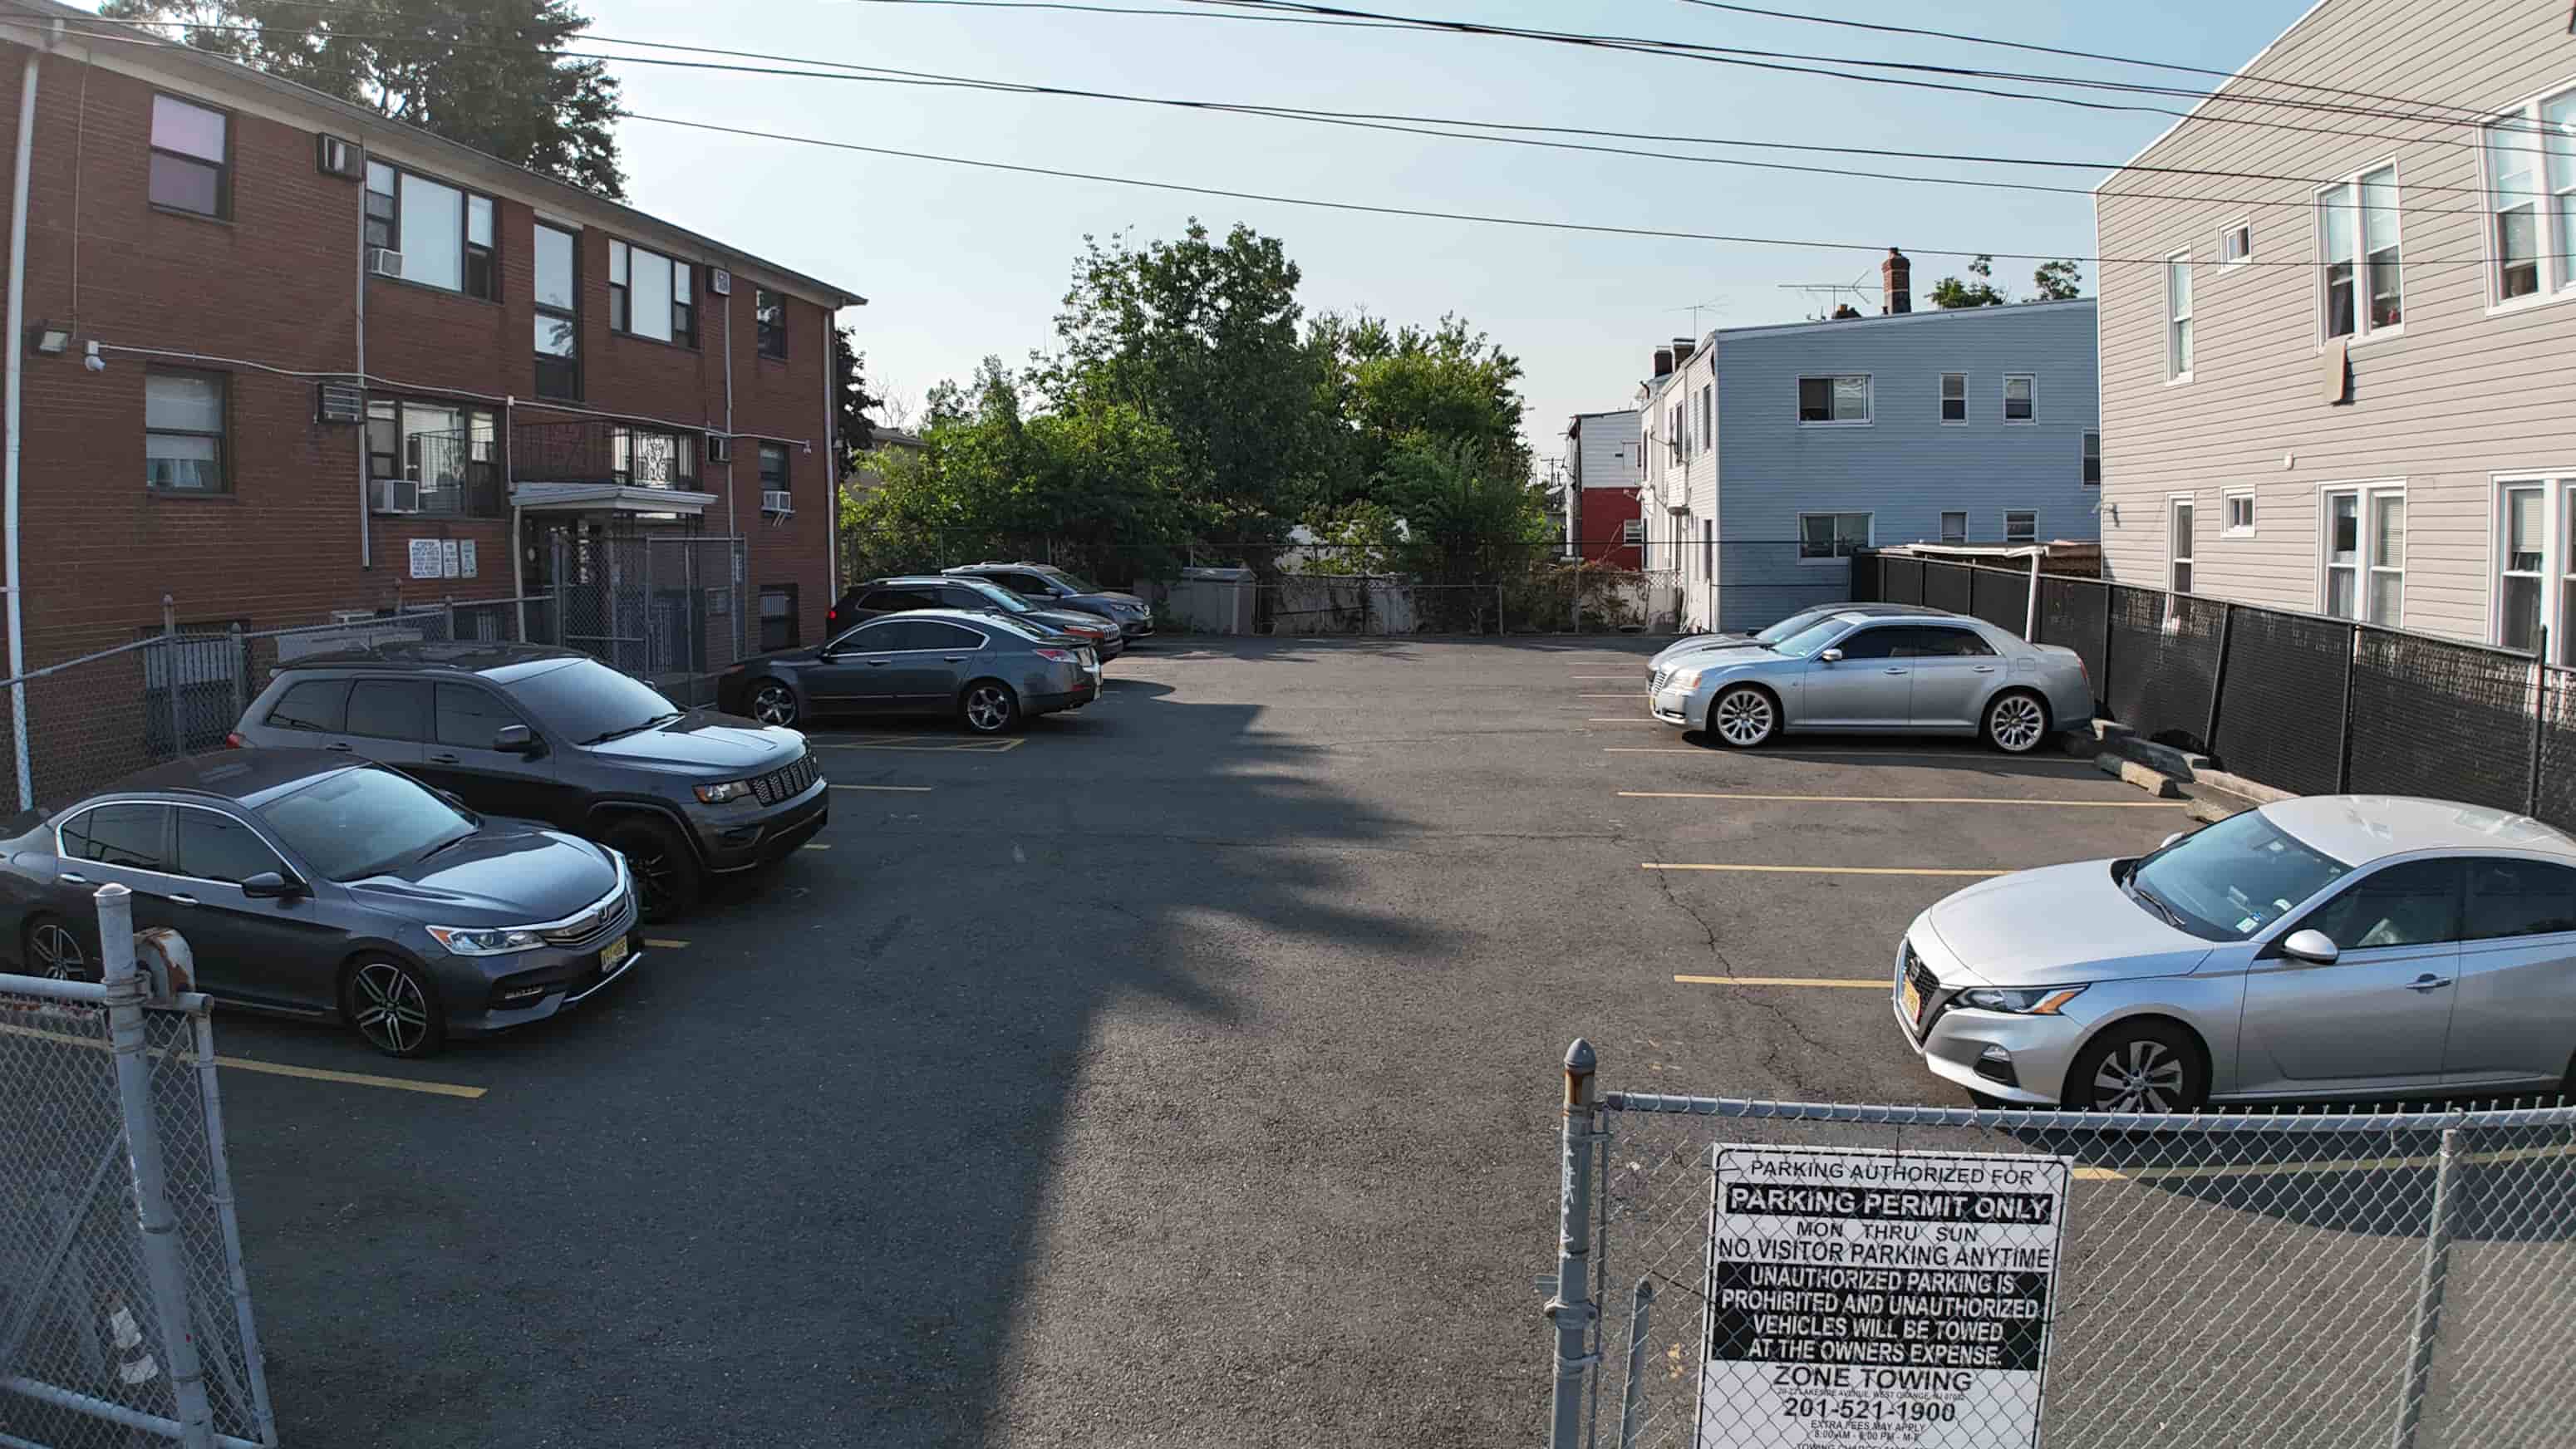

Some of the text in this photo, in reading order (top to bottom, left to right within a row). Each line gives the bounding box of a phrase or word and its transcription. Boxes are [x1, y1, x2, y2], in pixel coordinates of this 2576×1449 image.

[1751, 1161, 2033, 1185] PARKING AUTHORIZED FOR
[1731, 1188, 2048, 1220] PARKING PERMIT ONLY
[1797, 1222, 1976, 1242] MON THRU SUN
[1719, 1239, 2050, 1268] NO VISITOR PARKING ANYTIME
[1751, 1265, 2014, 1294] UNAUTHORIZED PARKING IS
[1721, 1289, 2038, 1319] PROHIBITED AND UNAUTHORIZED
[1753, 1314, 2003, 1342] VEHICLES WILL BE TOWED
[1748, 1338, 2002, 1365] AT THE OWNERS EXPENSE.
[1773, 1366, 1972, 1391] ZONE TOWING
[1784, 1397, 1955, 1422] 201-521-1900
[1812, 1420, 1925, 1432] EXTRA FEES MAY APPLY
[1836, 1431, 1850, 1439] AM
[1880, 1432, 1894, 1441] PM
